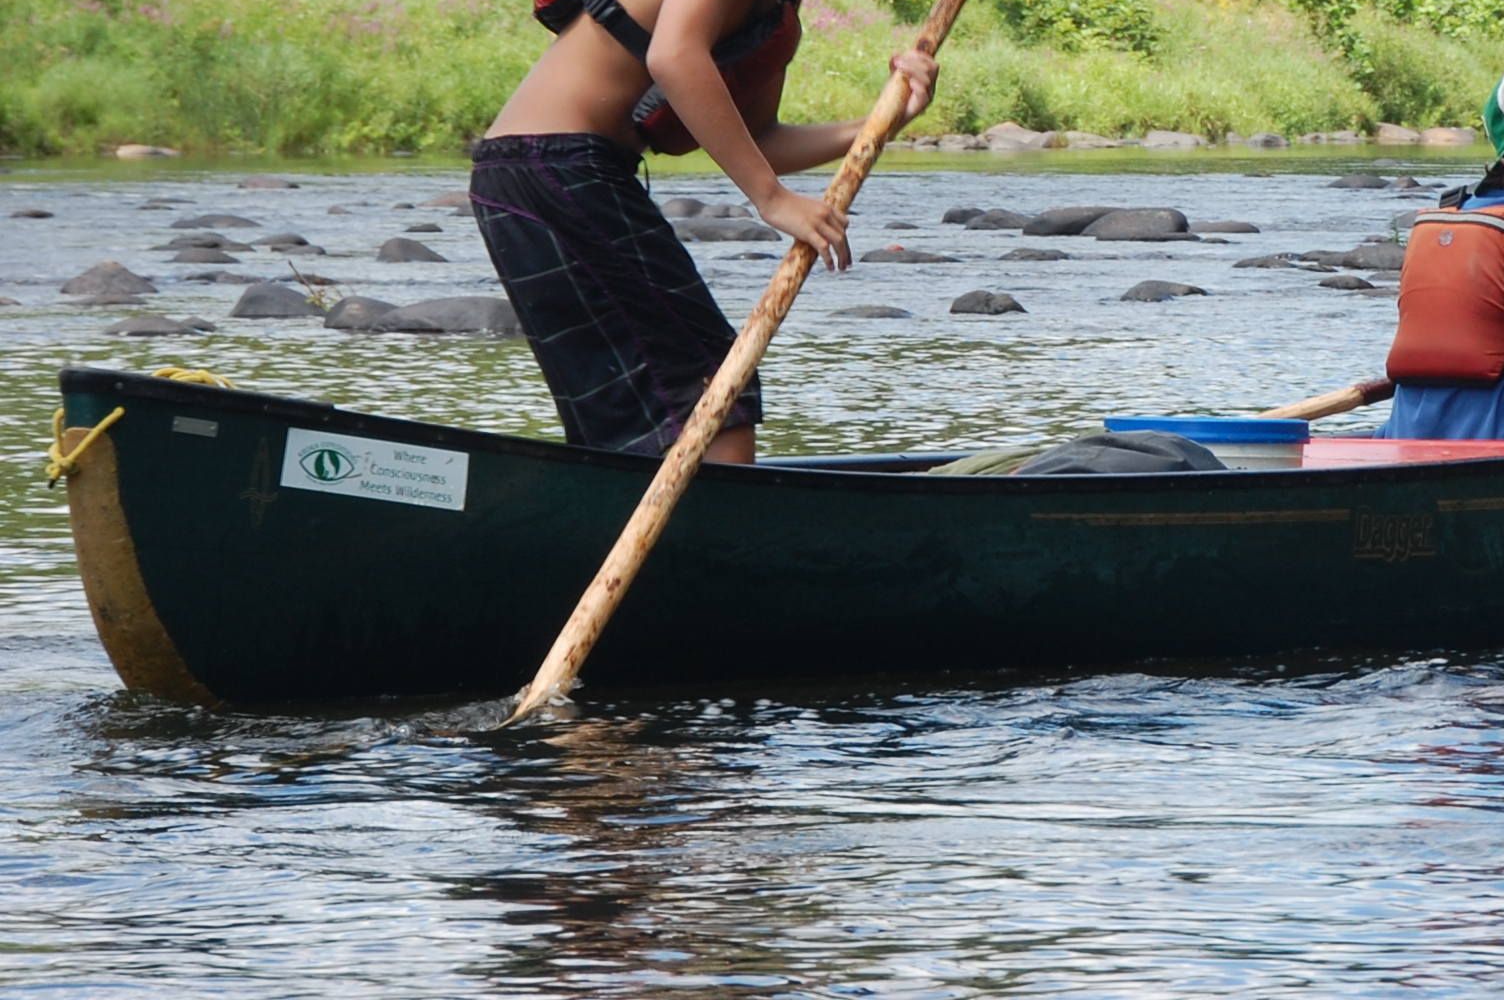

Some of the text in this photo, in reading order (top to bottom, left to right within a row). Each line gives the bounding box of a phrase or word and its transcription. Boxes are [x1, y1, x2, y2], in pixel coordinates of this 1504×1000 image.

[393, 449, 427, 465] Where
[369, 463, 446, 485] Consciousness
[360, 480, 391, 495] Meets
[395, 485, 452, 503] Wilderness
[1355, 505, 1434, 562] Dagger
